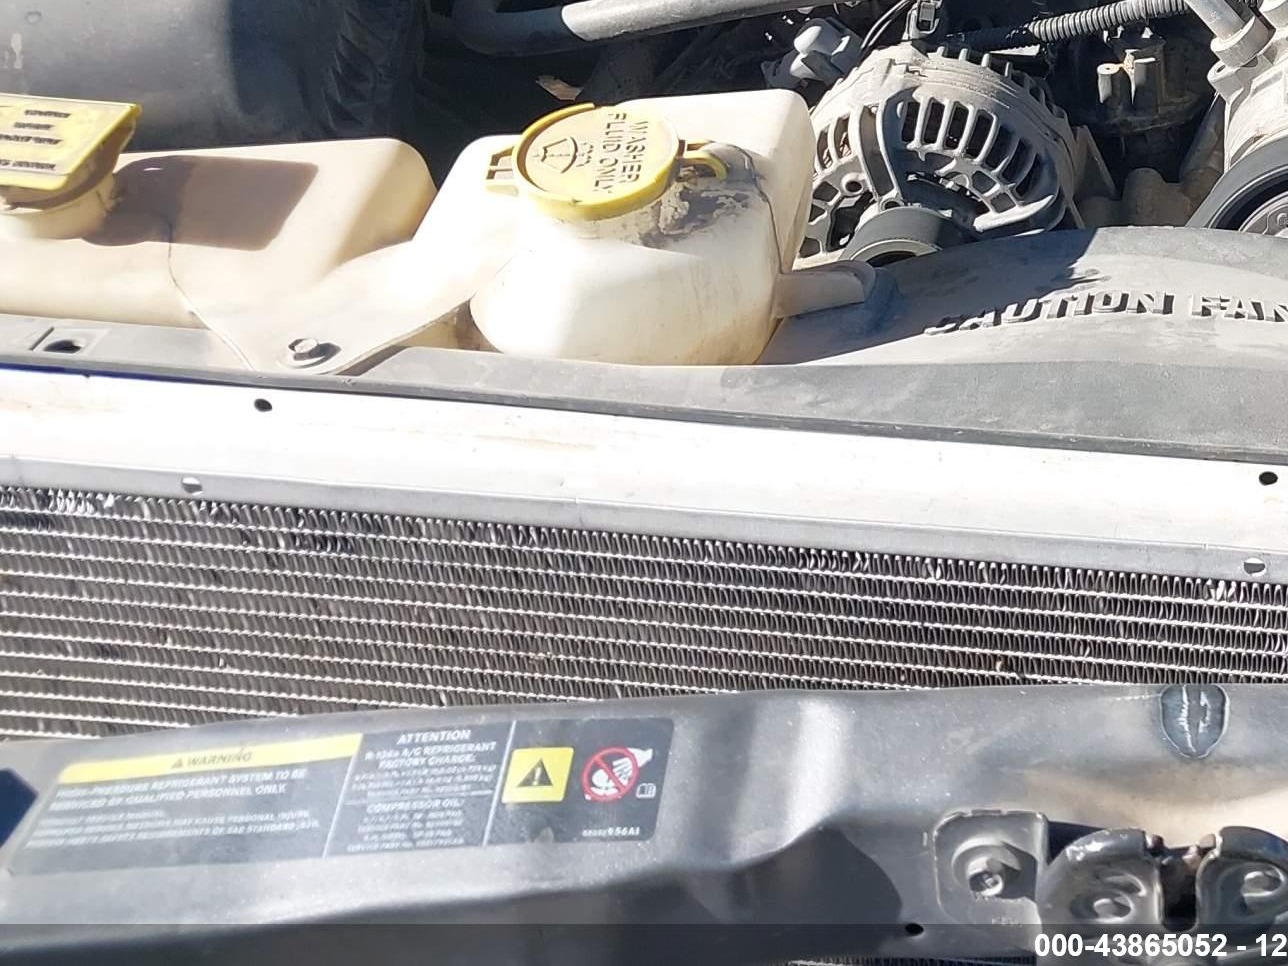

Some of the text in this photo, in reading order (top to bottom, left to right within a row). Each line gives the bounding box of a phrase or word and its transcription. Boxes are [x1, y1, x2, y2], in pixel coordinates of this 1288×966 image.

[594, 113, 628, 194] FLUID ONLY
[623, 119, 649, 184] WASHER
[396, 729, 472, 745] ATTENTION
[187, 750, 253, 767] WARNING
